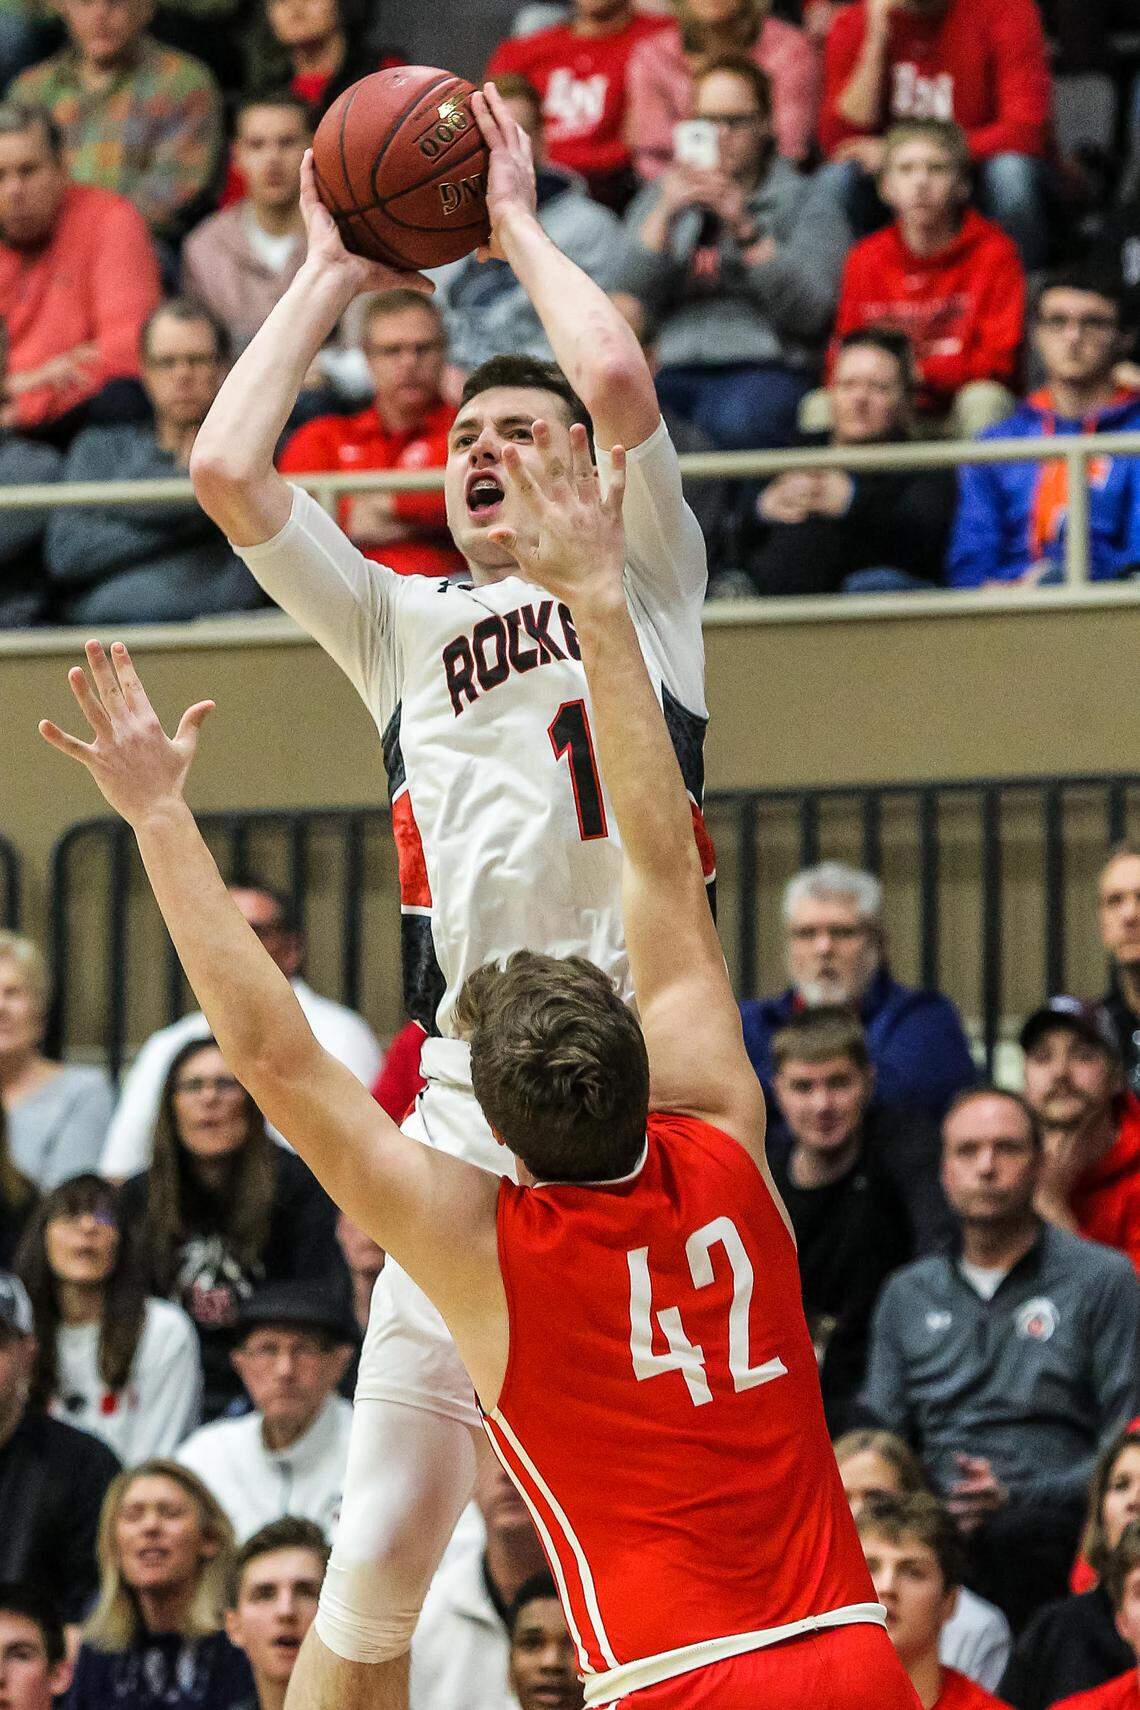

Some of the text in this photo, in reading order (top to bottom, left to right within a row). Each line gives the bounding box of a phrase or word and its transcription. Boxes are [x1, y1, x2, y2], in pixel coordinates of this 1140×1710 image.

[442, 600, 582, 718] ROCKE
[547, 699, 609, 841] 1
[627, 1216, 788, 1407] 42
